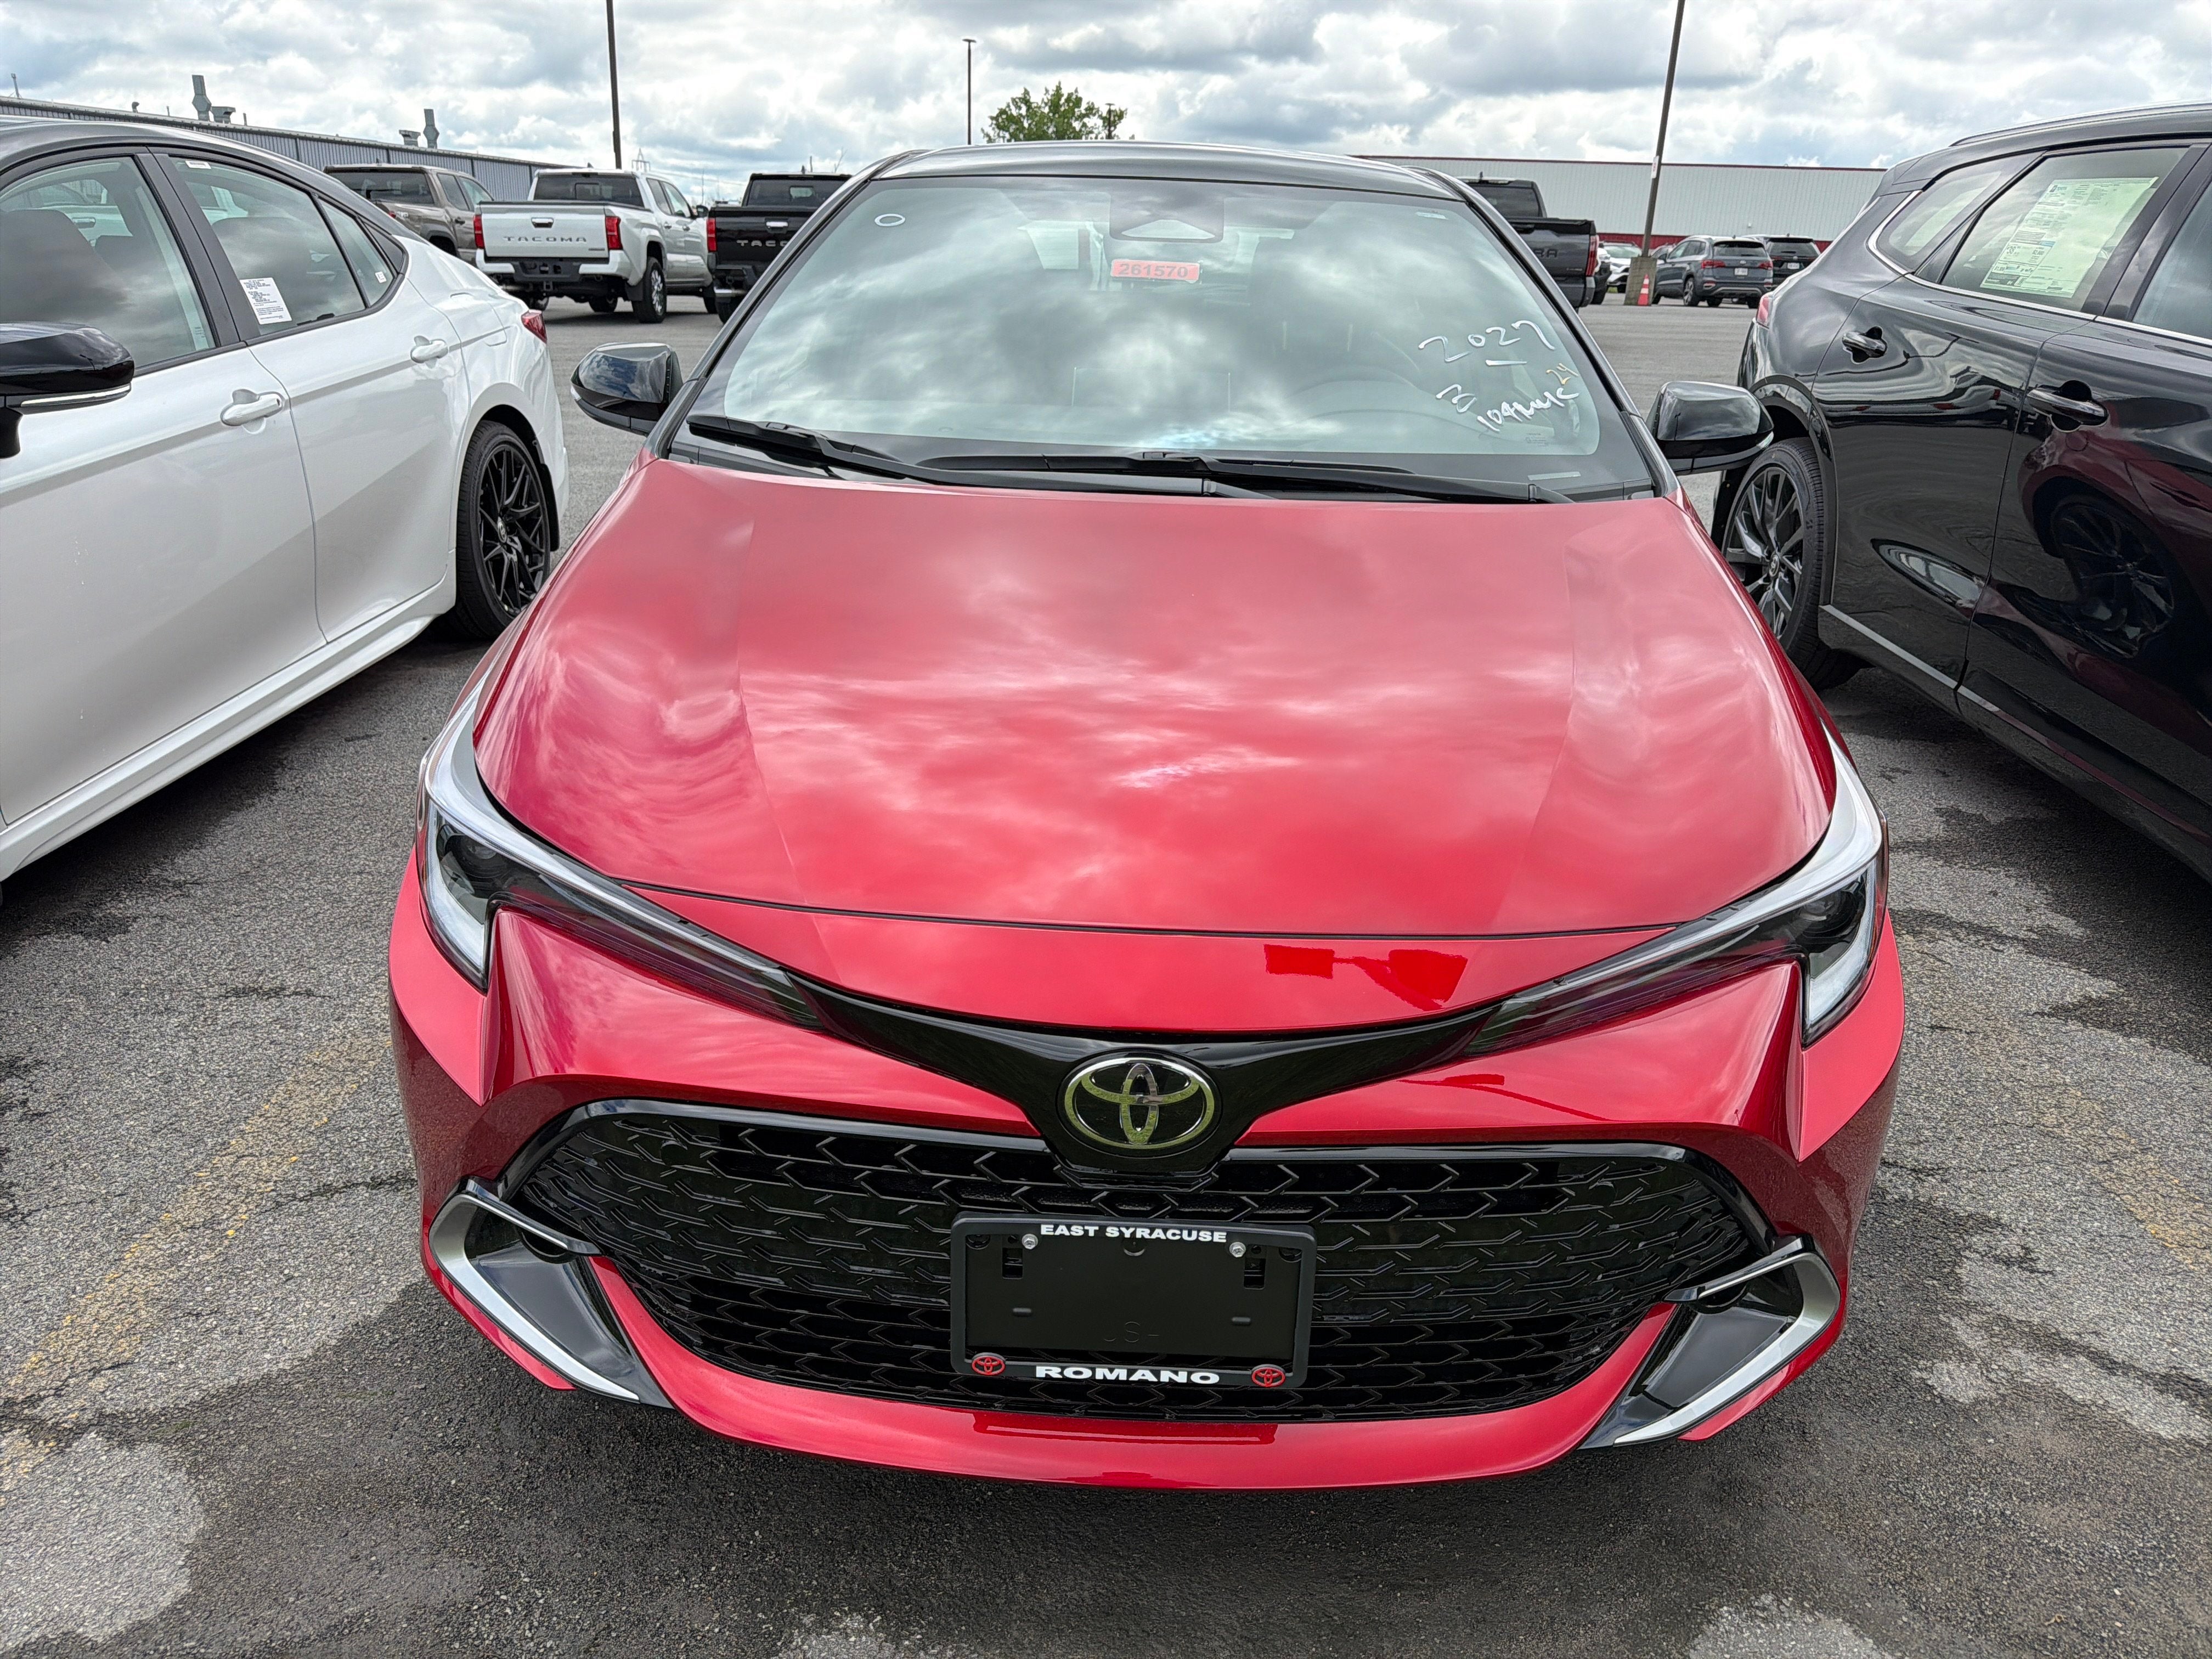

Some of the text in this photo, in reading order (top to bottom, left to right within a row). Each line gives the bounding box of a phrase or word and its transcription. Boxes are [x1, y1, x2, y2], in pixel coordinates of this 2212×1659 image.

[1118, 263, 1189, 278] 261570
[1418, 320, 1555, 362] 2027
[1040, 1224, 1227, 1243] EAST SYRACUSE
[1036, 1365, 1220, 1385] ROMANO
